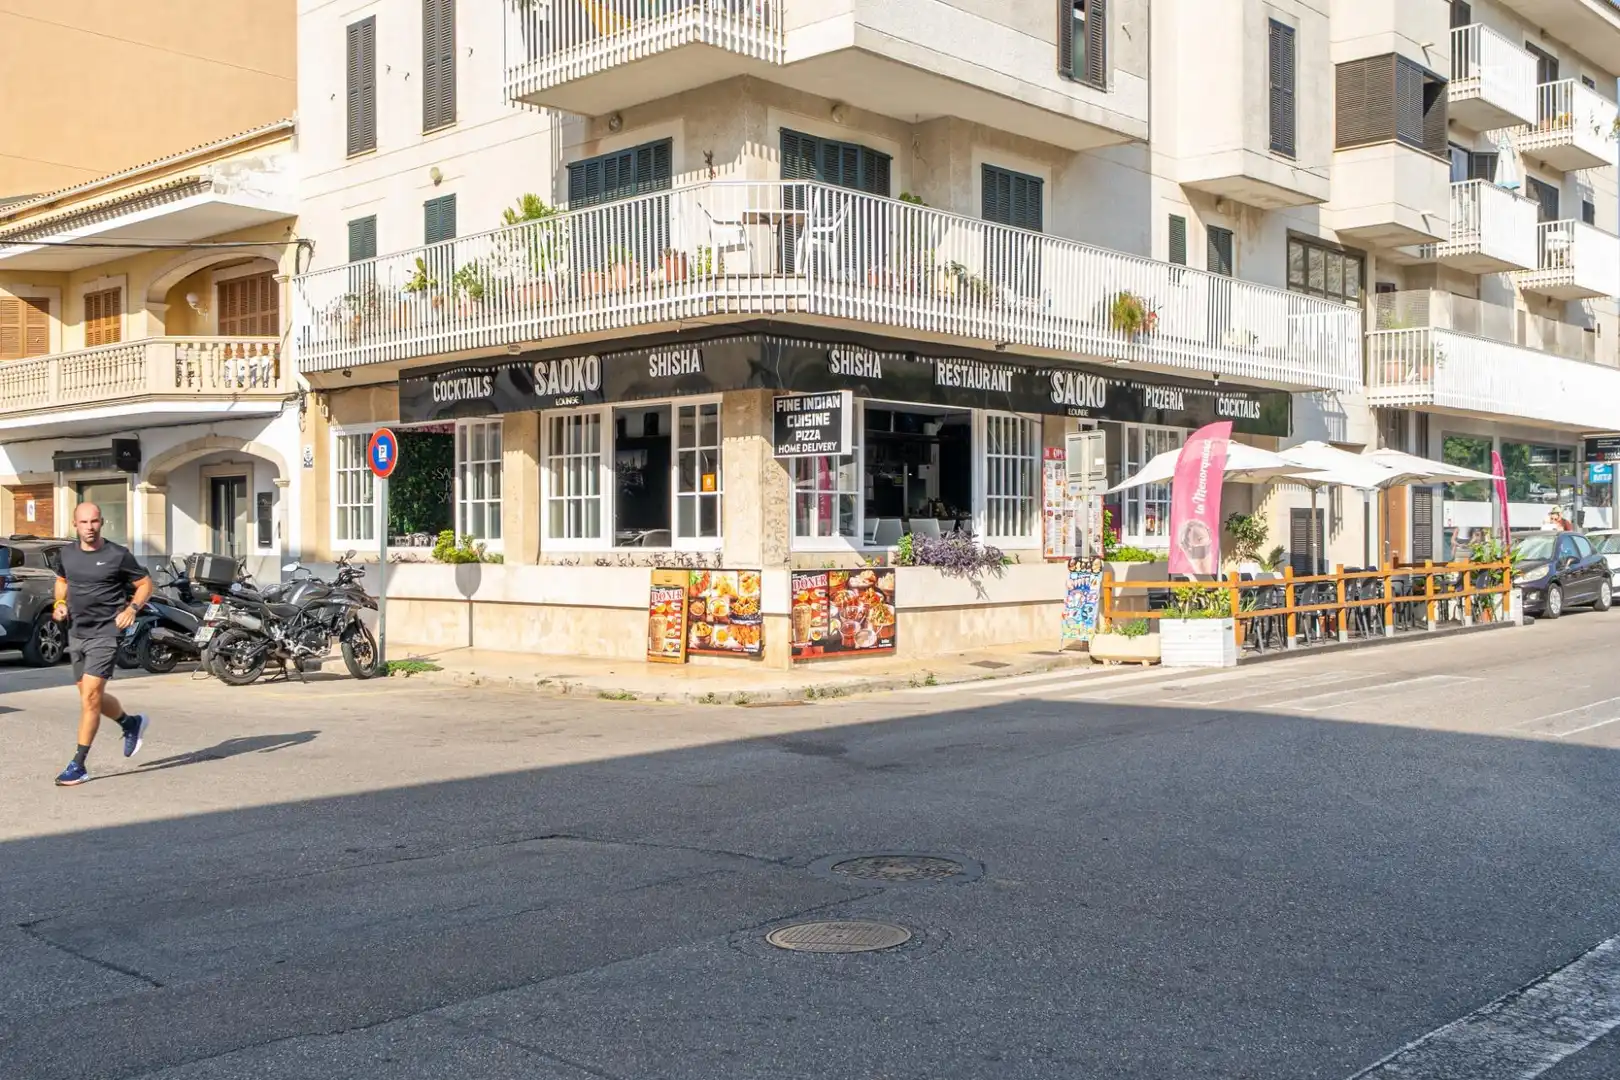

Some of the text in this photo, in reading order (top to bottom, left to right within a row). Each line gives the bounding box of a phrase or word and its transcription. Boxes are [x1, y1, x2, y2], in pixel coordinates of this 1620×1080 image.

[649, 349, 701, 377] SHISHA
[830, 350, 882, 378] SHISHA
[534, 355, 601, 397] SAOKO
[936, 362, 1013, 392] RESTAURANT
[433, 376, 492, 402] COCKTAILS
[1051, 371, 1106, 408] SAOKO
[1145, 386, 1184, 411] PIZZERIA
[776, 395, 841, 412] FINE INDIAN
[1218, 397, 1261, 419] COCKTAILS
[786, 412, 831, 428] CUISINE
[778, 441, 837, 454] HOME DELIVERY
[795, 429, 821, 441] PIZZA
